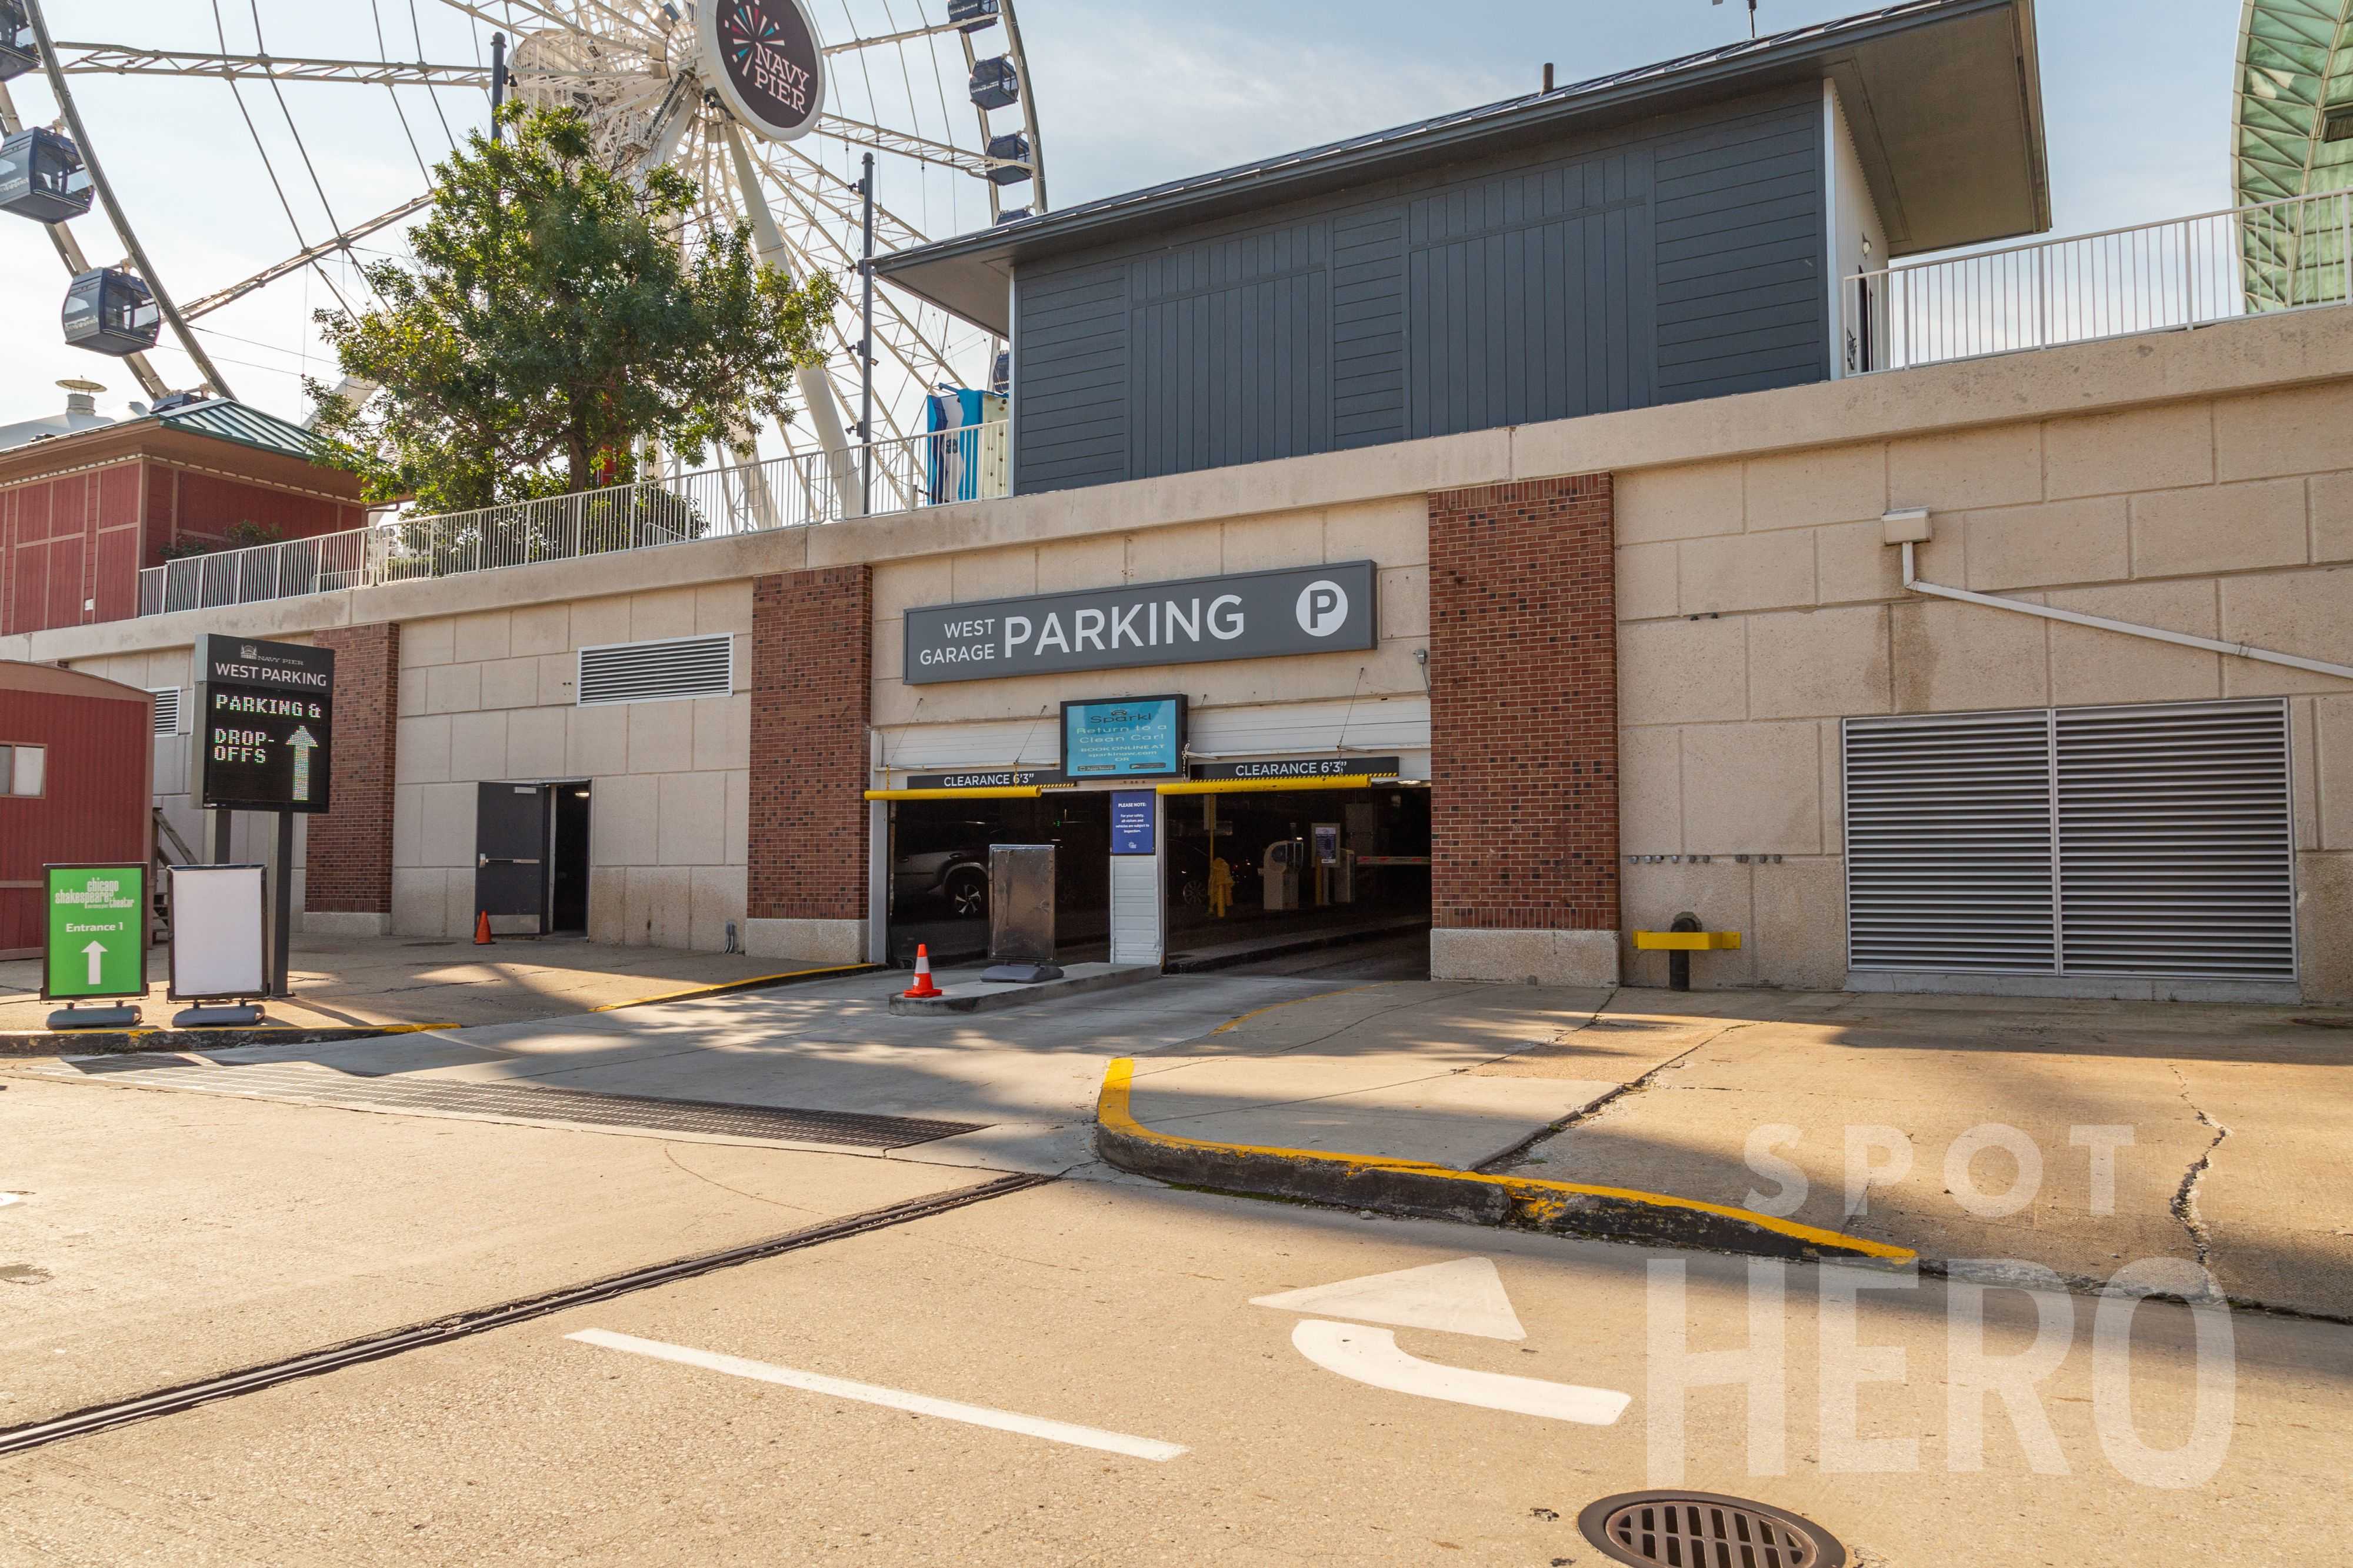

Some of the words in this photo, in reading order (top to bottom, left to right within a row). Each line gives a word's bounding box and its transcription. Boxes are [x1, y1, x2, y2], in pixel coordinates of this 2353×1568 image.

[755, 42, 809, 92] NAVY
[754, 65, 805, 115] PIER
[1309, 589, 1338, 629] P
[944, 619, 995, 638] WEST
[1004, 594, 1245, 658] PARKING
[258, 655, 280, 663] NAVY
[919, 643, 995, 666] GARAGE
[215, 662, 259, 679] WEST
[262, 668, 326, 687] PARKING
[216, 694, 303, 716] PARKING
[309, 703, 321, 718] &
[1090, 713, 1152, 724] Sparkl
[214, 728, 275, 746] DROP-
[214, 746, 266, 763] OFFS
[1235, 762, 1317, 776] CLEARANCE
[944, 775, 1009, 787] CLEARANCE
[87, 877, 119, 897] chicago
[55, 889, 109, 909] shakespeare
[66, 923, 116, 932] Entrance
[118, 922, 124, 930] 1
